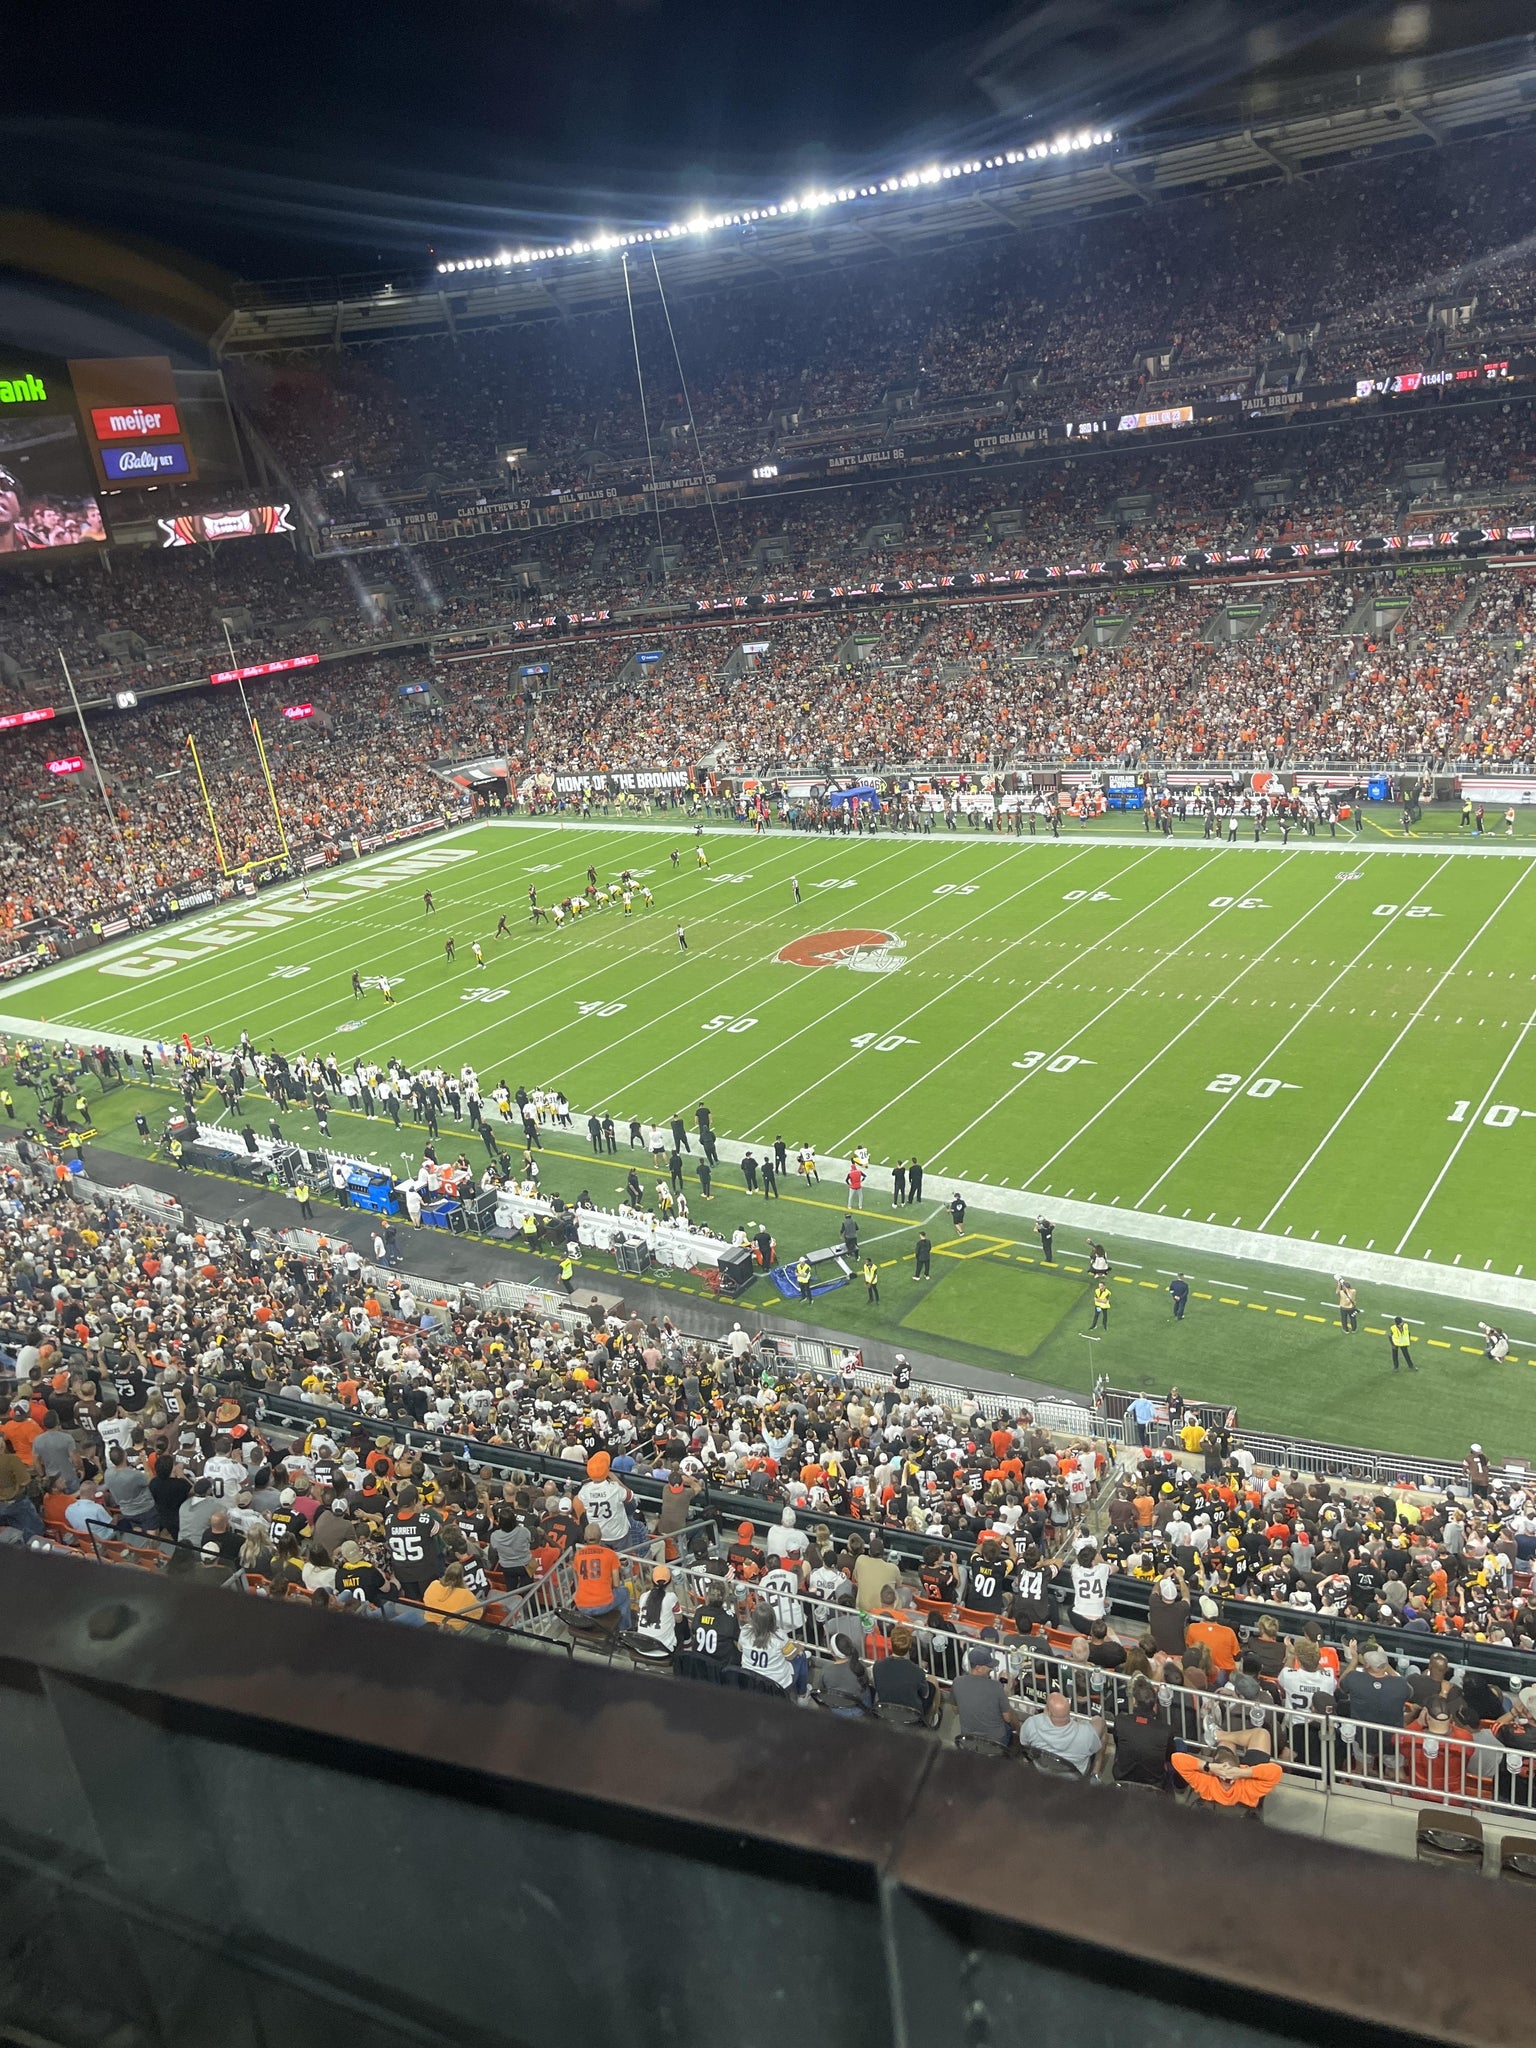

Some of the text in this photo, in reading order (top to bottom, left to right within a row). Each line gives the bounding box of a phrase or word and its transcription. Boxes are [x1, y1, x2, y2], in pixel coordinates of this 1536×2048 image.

[1422, 373, 1440, 385] 11:04
[1486, 369, 1496, 378] 23
[1500, 368, 1507, 376] 4
[0, 373, 48, 403] ank
[1241, 391, 1304, 410] PAUL BROWN
[109, 408, 162, 434] meijer
[973, 428, 1048, 448] OTTO GRAHAM 14
[119, 450, 174, 472] Bally BET
[828, 448, 905, 468] DANTE LAVELLI 86
[752, 466, 778, 479] 11:04
[642, 473, 717, 493] MARION MOTLEY 36
[558, 487, 617, 504] BILL WILLIS 60
[457, 499, 531, 518] CLAY MATTHEWS 57
[385, 511, 438, 528] LEN FORD 80
[118, 693, 136, 708] 09
[48, 761, 72, 775] Bally
[555, 775, 591, 793] HOME
[611, 773, 635, 790] THE
[636, 771, 689, 789] BROWNS
[860, 779, 880, 791] 1946
[710, 873, 753, 884] 30
[814, 878, 858, 889] 40
[932, 883, 980, 896] 50
[1061, 889, 1108, 902] 40
[178, 889, 214, 910] BROWNS
[1208, 896, 1265, 910] 30
[98, 848, 479, 978] CLEVELAND
[1371, 904, 1431, 918] 20
[271, 964, 312, 979] 10
[460, 987, 511, 1003] 30
[577, 1000, 628, 1017] 40
[700, 1014, 759, 1033] 50
[849, 1032, 908, 1052] 40
[1011, 1050, 1082, 1074] 30
[1204, 1072, 1282, 1098] 20
[1446, 1099, 1520, 1128] 10
[444, 1183, 454, 1194] G
[845, 1363, 857, 1374] 24
[115, 1384, 136, 1398] 73
[164, 1397, 180, 1413] 19
[80, 1415, 97, 1431] 21
[584, 1437, 596, 1448] 90
[1476, 1462, 1483, 1474] 1
[968, 1479, 983, 1491] 85
[1072, 1481, 1084, 1492] 80
[589, 1491, 607, 1499] THOMAS
[1195, 1496, 1205, 1510] 22
[588, 1500, 613, 1520] 73
[1213, 1510, 1225, 1521] 90
[391, 1525, 417, 1536] GARRETT
[388, 1536, 424, 1562] 95
[1015, 1542, 1026, 1554] 10
[979, 1566, 993, 1576] WATT
[1236, 1559, 1247, 1575] 84
[343, 1577, 361, 1588] WATT
[463, 1567, 489, 1591] 24
[816, 1580, 835, 1590] CHUBB
[974, 1573, 996, 1598] 90
[1019, 1571, 1043, 1600] 44
[923, 1582, 942, 1600] 13
[1078, 1578, 1104, 1600] 24
[700, 1615, 715, 1625] WATT
[696, 1626, 718, 1654] 90
[750, 1649, 769, 1668] 90
[1299, 1684, 1321, 1693] CHUBB
